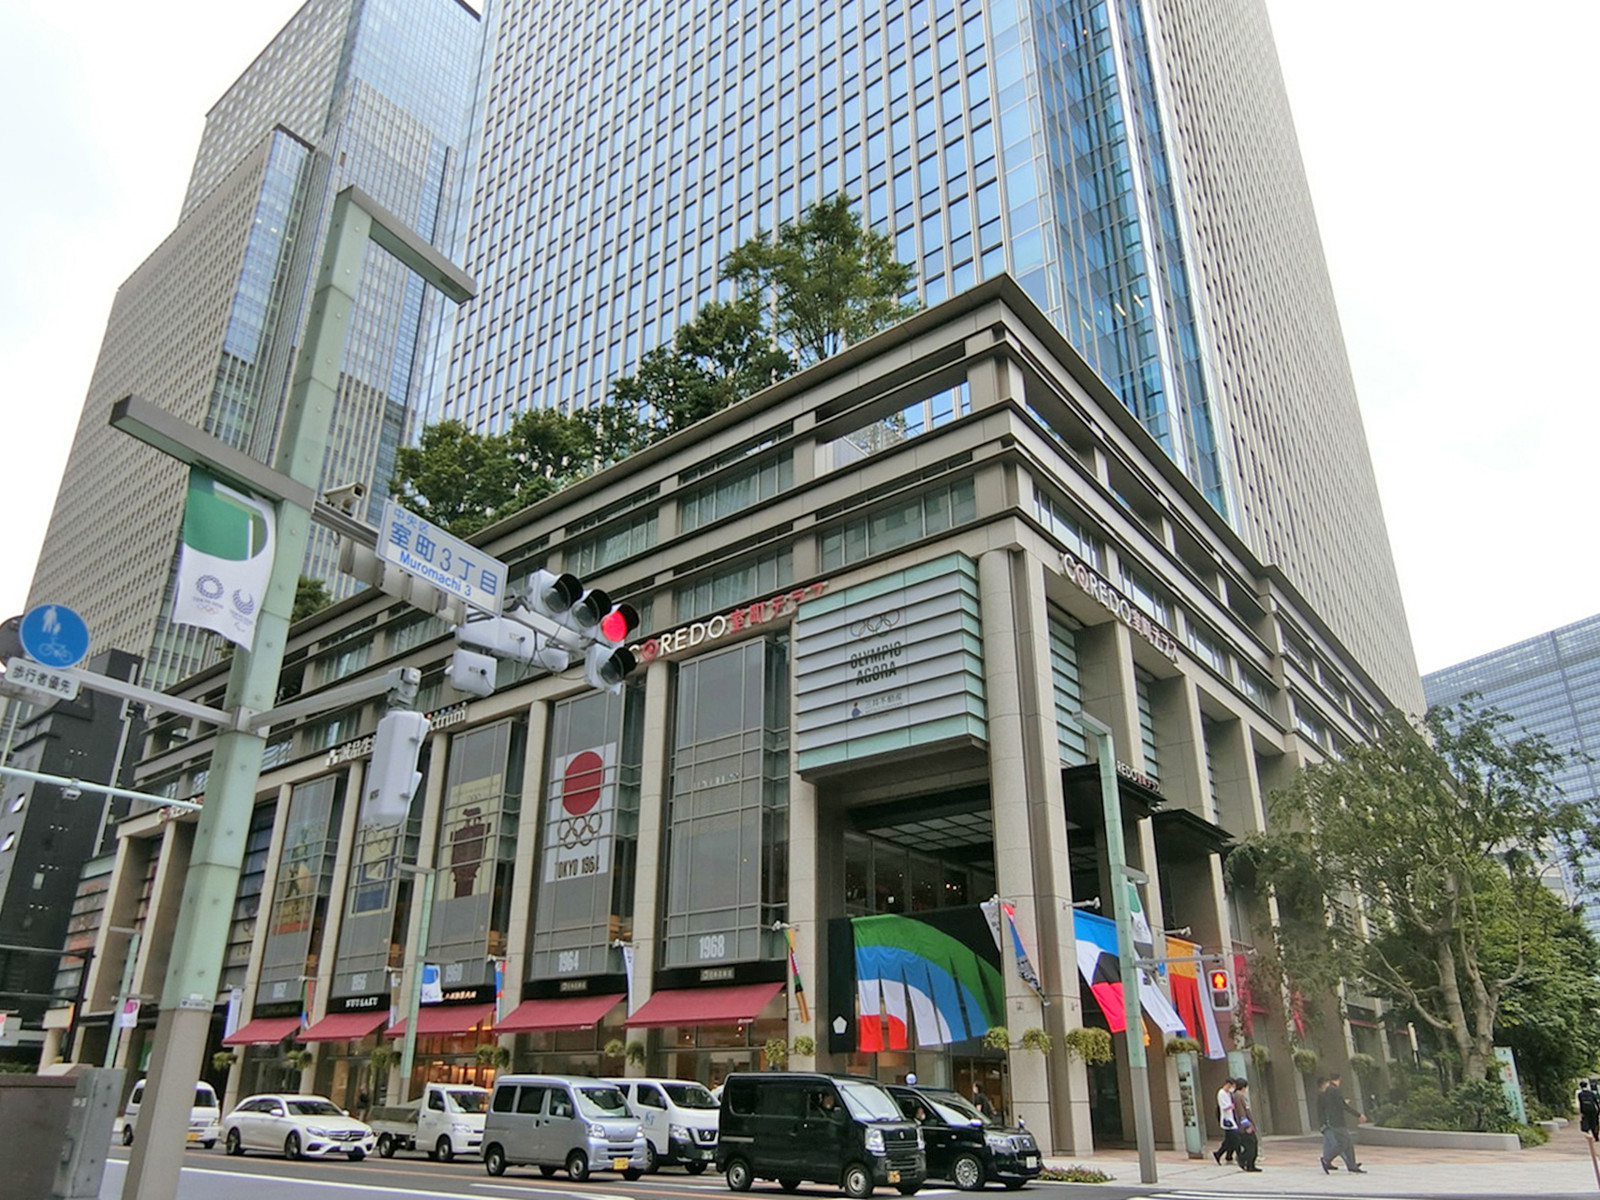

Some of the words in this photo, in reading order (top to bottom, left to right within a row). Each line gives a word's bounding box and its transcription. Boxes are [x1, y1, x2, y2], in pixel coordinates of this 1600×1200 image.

[394, 507, 429, 535] 中央区
[388, 520, 498, 596] 室町3丁目
[399, 549, 462, 592] Muromachi
[464, 584, 472, 597] 3
[11, 664, 72, 695] 歩行者優先
[855, 660, 898, 687] AGORA
[429, 708, 466, 731] ctrum
[699, 934, 726, 959] 1968
[558, 950, 580, 973] 1964
